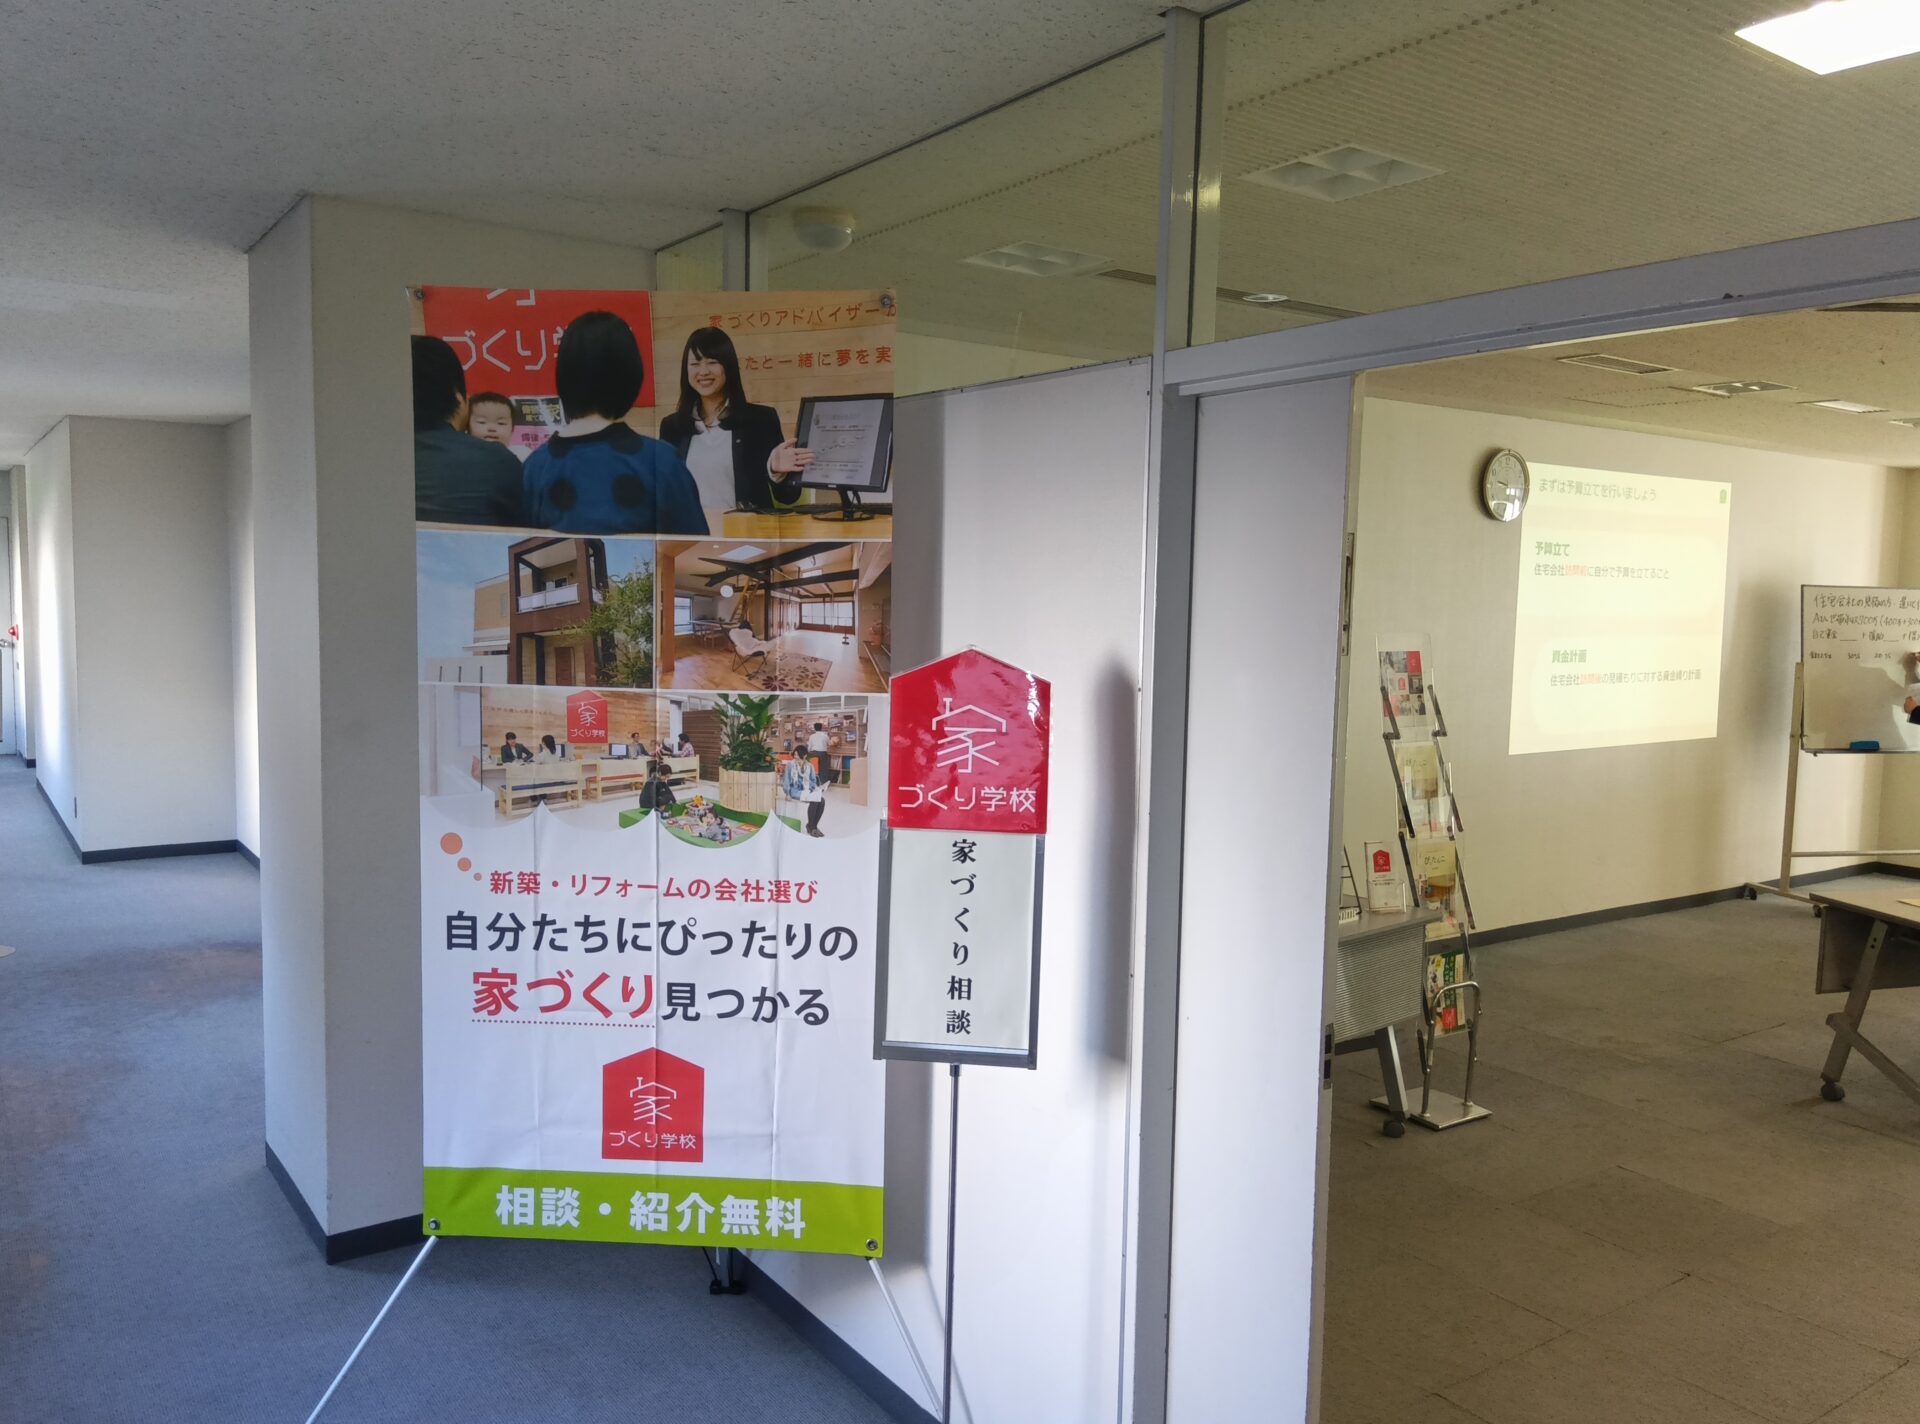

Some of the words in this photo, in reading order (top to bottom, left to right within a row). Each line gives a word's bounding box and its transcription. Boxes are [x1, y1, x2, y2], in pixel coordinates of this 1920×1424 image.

[442, 326, 568, 373] づくり
[1535, 541, 1570, 557] 予算立て
[570, 728, 606, 738] づくり学校
[578, 702, 598, 727] 家
[931, 697, 1007, 773] 家
[898, 784, 1038, 813] づくり学校
[489, 870, 818, 903] 新築・リフォームの会社選び
[445, 910, 859, 962] 自分たちにぴったりの
[945, 838, 977, 1036] 家づくり相談
[471, 967, 830, 1026] 家づくり見つかる
[629, 1076, 677, 1125] 家
[608, 1130, 698, 1151] づくり学校
[495, 1184, 807, 1239] 相談・紹介無料
